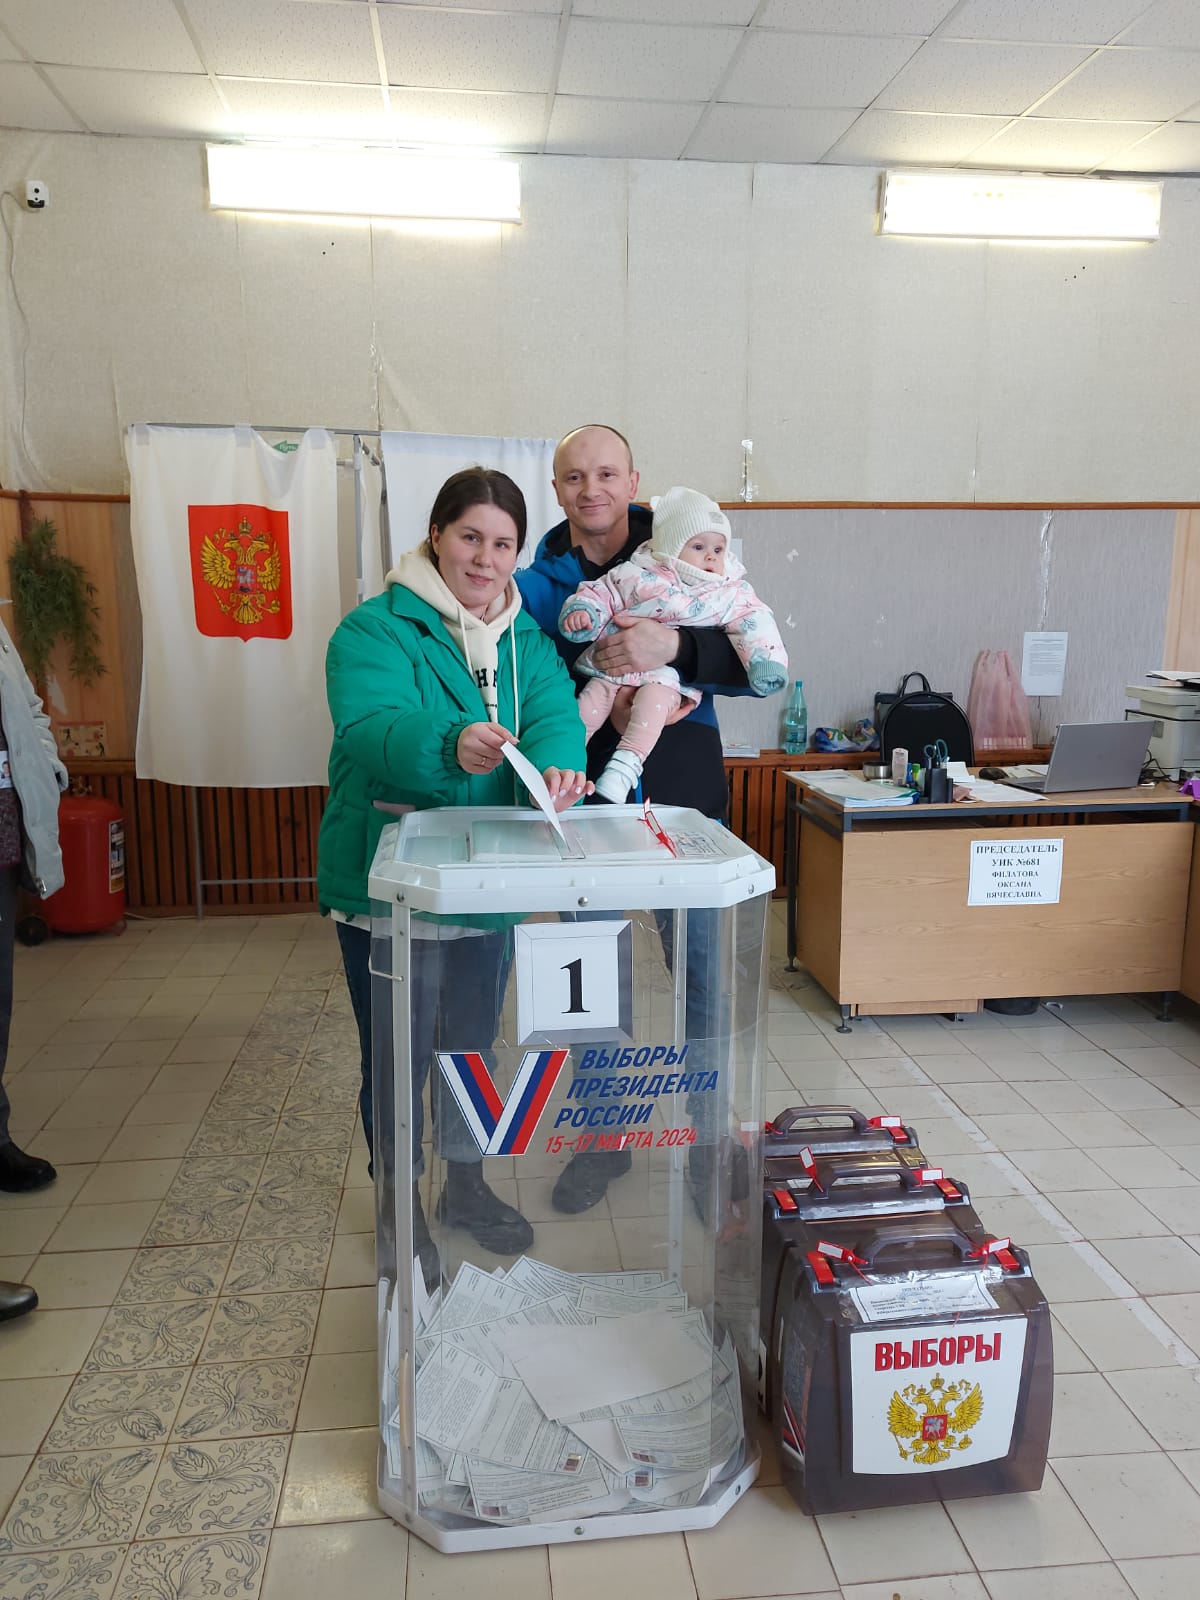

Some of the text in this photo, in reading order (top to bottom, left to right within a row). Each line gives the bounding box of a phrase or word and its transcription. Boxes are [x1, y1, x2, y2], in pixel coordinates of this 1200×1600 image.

[976, 845, 1058, 854] ПРЕДСЕДАТЕЛЬ
[992, 859, 1013, 867] УИК
[986, 891, 1042, 899] ВЯЧЕСЛАВНА
[560, 958, 591, 1014] 1
[579, 1045, 689, 1070] ВЫБОРЫ
[566, 1071, 719, 1099] ПРЕЗИДЕНТА
[554, 1104, 654, 1129] РОССИИ
[594, 1130, 654, 1150] МАРТА
[656, 1128, 698, 1147] 2024
[874, 1332, 1002, 1372] ВЫБОРЫ
